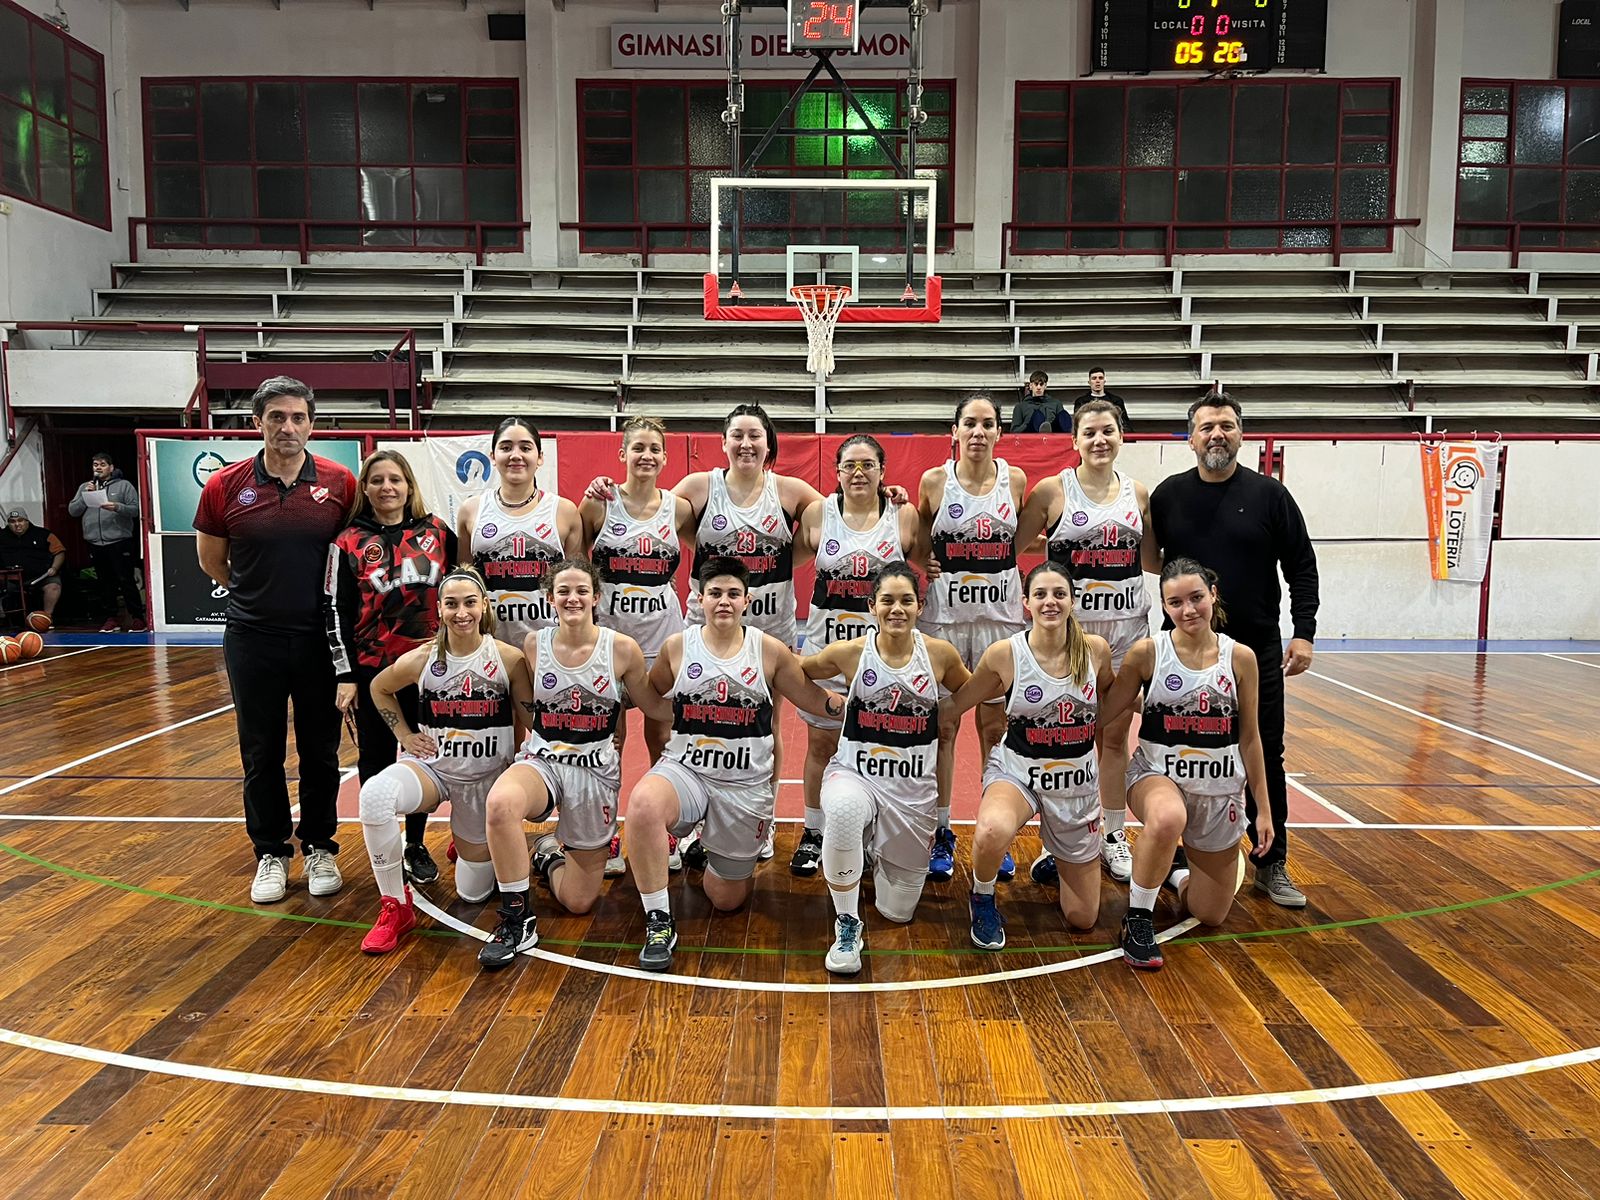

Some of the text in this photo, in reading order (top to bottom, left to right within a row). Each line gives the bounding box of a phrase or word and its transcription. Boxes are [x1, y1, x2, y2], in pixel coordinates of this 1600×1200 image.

[804, 1, 854, 39] 24
[1154, 15, 1205, 36] LOCAL 0
[1215, 15, 1266, 35] 0 VISITA
[1174, 42, 1204, 64] 05
[976, 518, 992, 540] 15
[1102, 524, 1119, 547] 14
[1447, 510, 1462, 569] LOTERIA
[512, 536, 526, 558] 11
[638, 537, 652, 556] 10
[736, 532, 756, 553] 23
[851, 555, 869, 578] 13
[948, 580, 1008, 608] Ferroli
[825, 618, 879, 644] Ferr
[461, 675, 472, 697] 4
[715, 680, 729, 703] 9
[571, 690, 582, 711] 5
[890, 688, 902, 712] 7
[1198, 691, 1210, 714] 6
[1057, 701, 1075, 724] 12
[679, 743, 751, 770] Ferroli
[856, 750, 924, 778] Ferroli
[1164, 754, 1235, 779] Ferroli
[603, 806, 610, 825] 5
[1228, 803, 1237, 822] 6
[755, 820, 764, 839] 9
